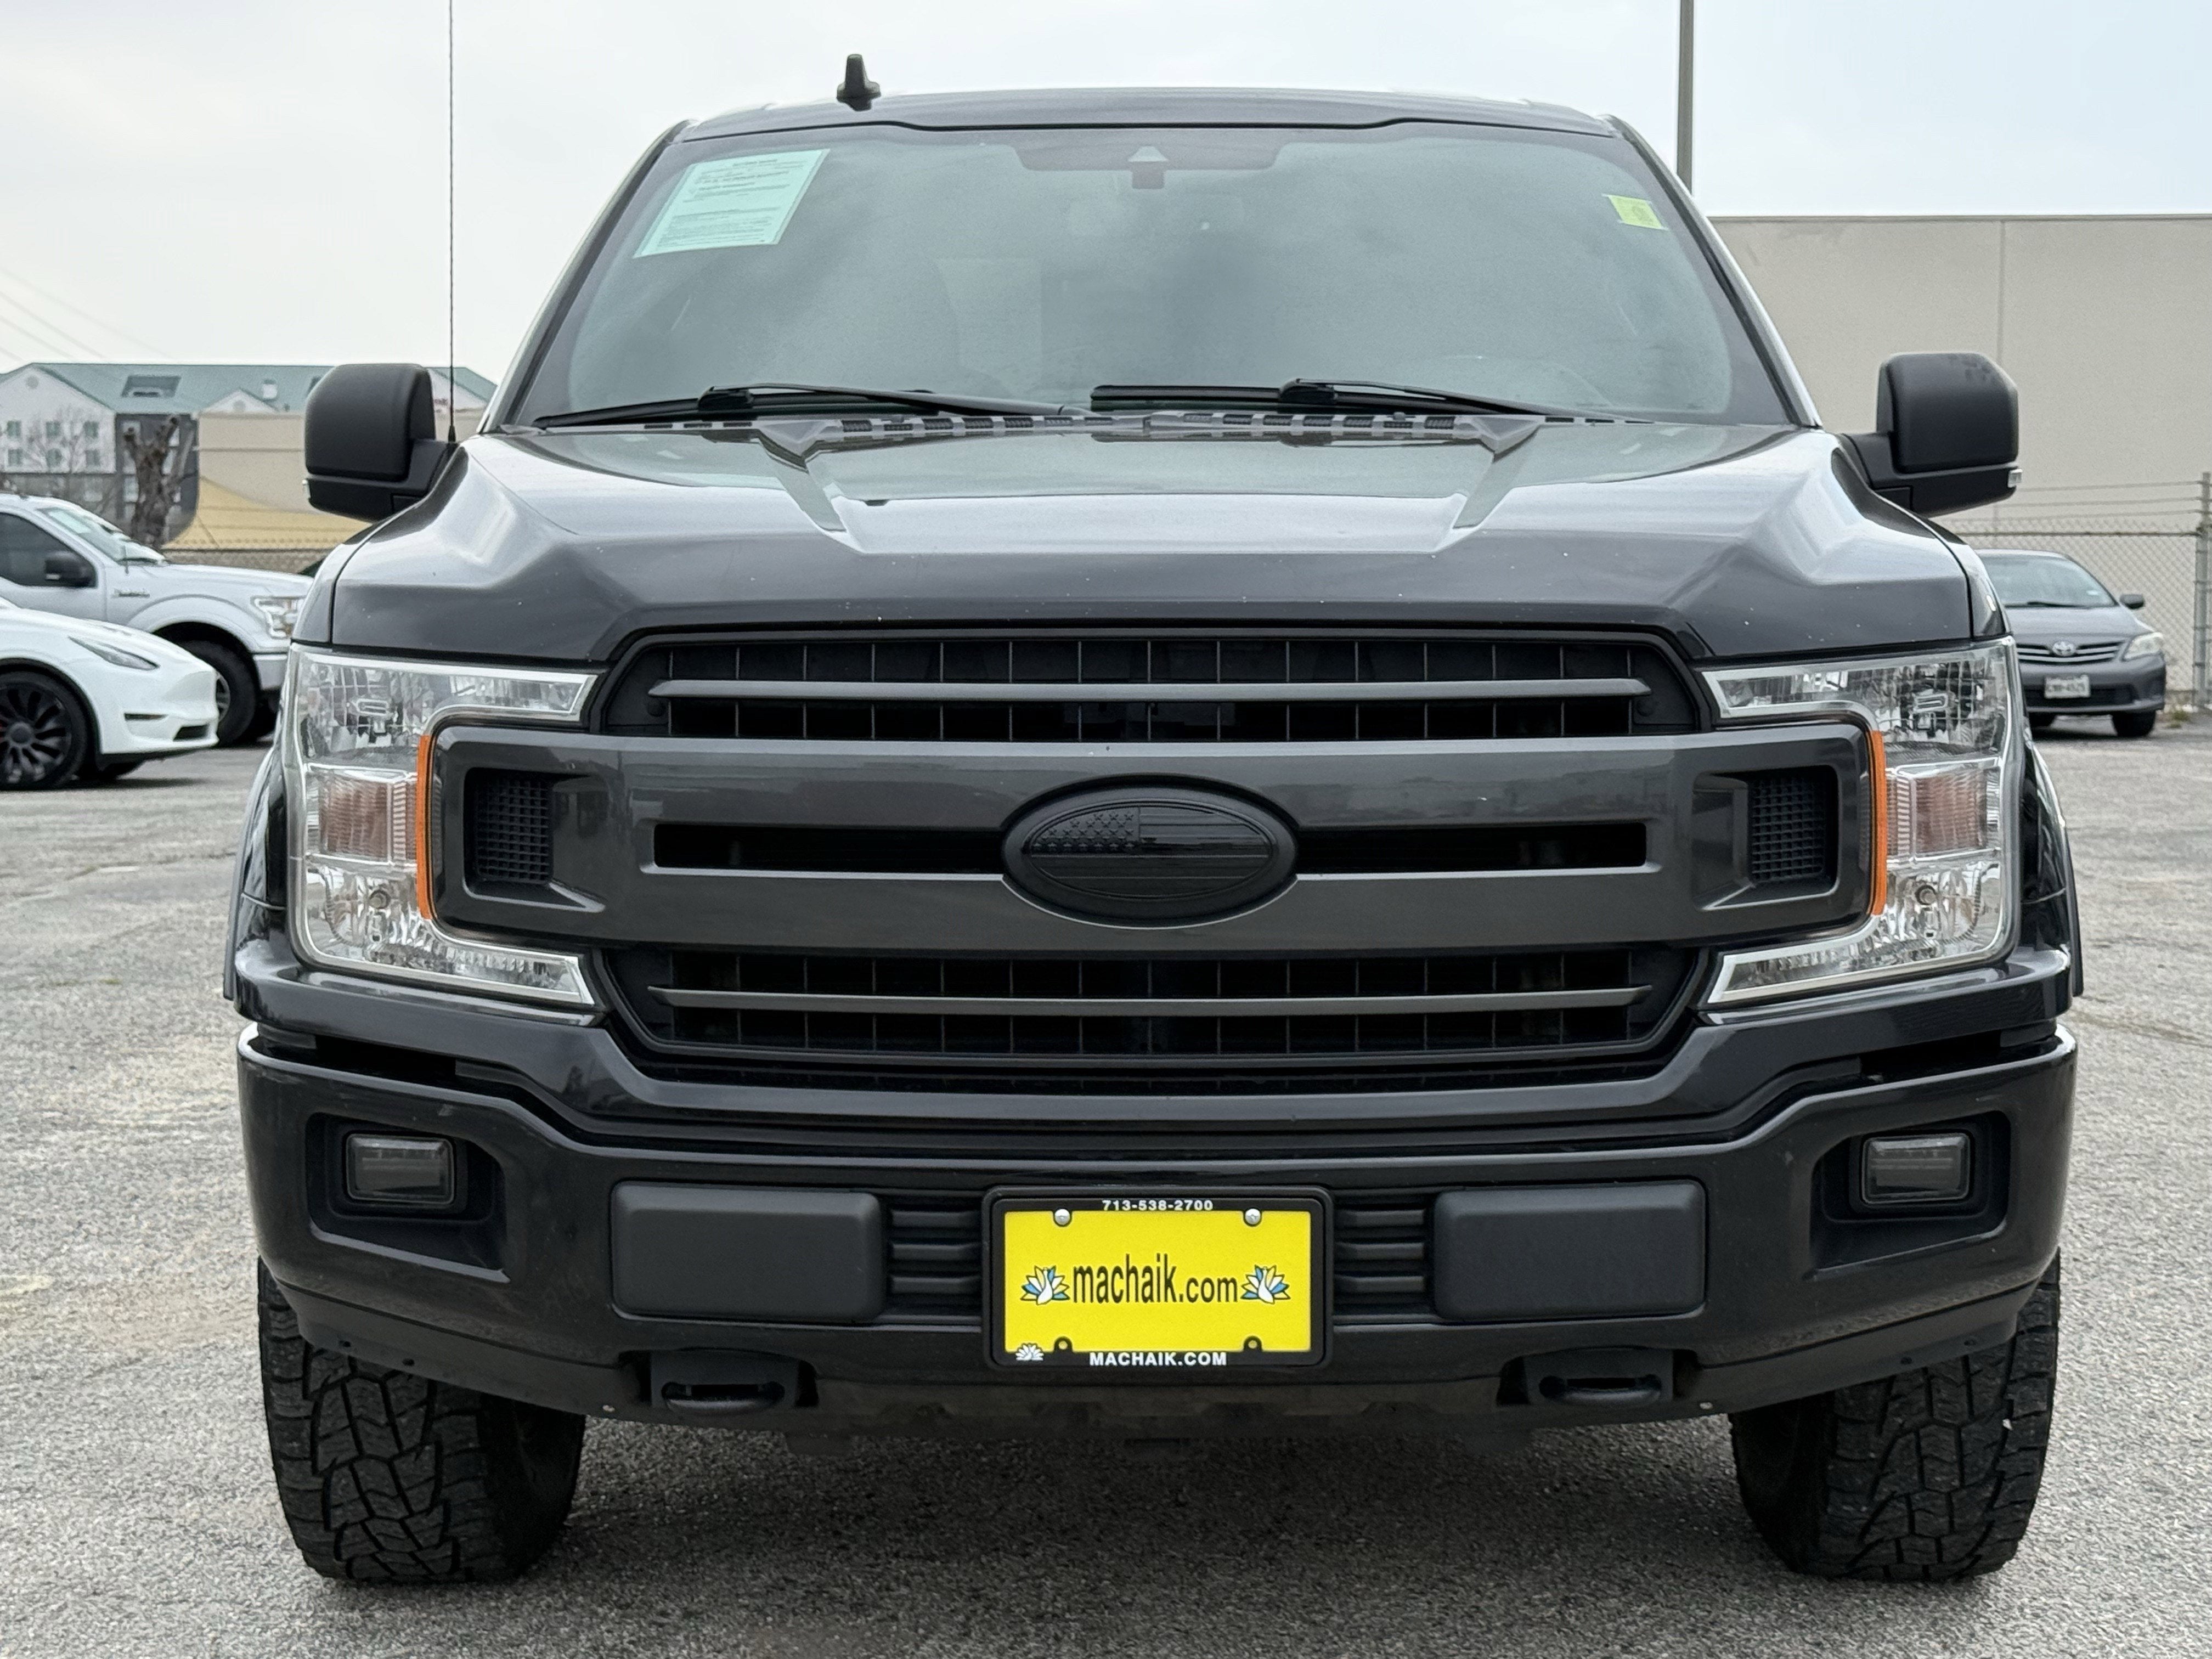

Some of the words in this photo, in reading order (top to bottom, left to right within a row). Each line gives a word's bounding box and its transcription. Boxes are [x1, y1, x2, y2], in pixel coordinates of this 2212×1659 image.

[1102, 1200, 1214, 1211] 713-538-2700
[1073, 1254, 1238, 1303] machaik.com
[1090, 1353, 1227, 1366] MACHAIK.COM
